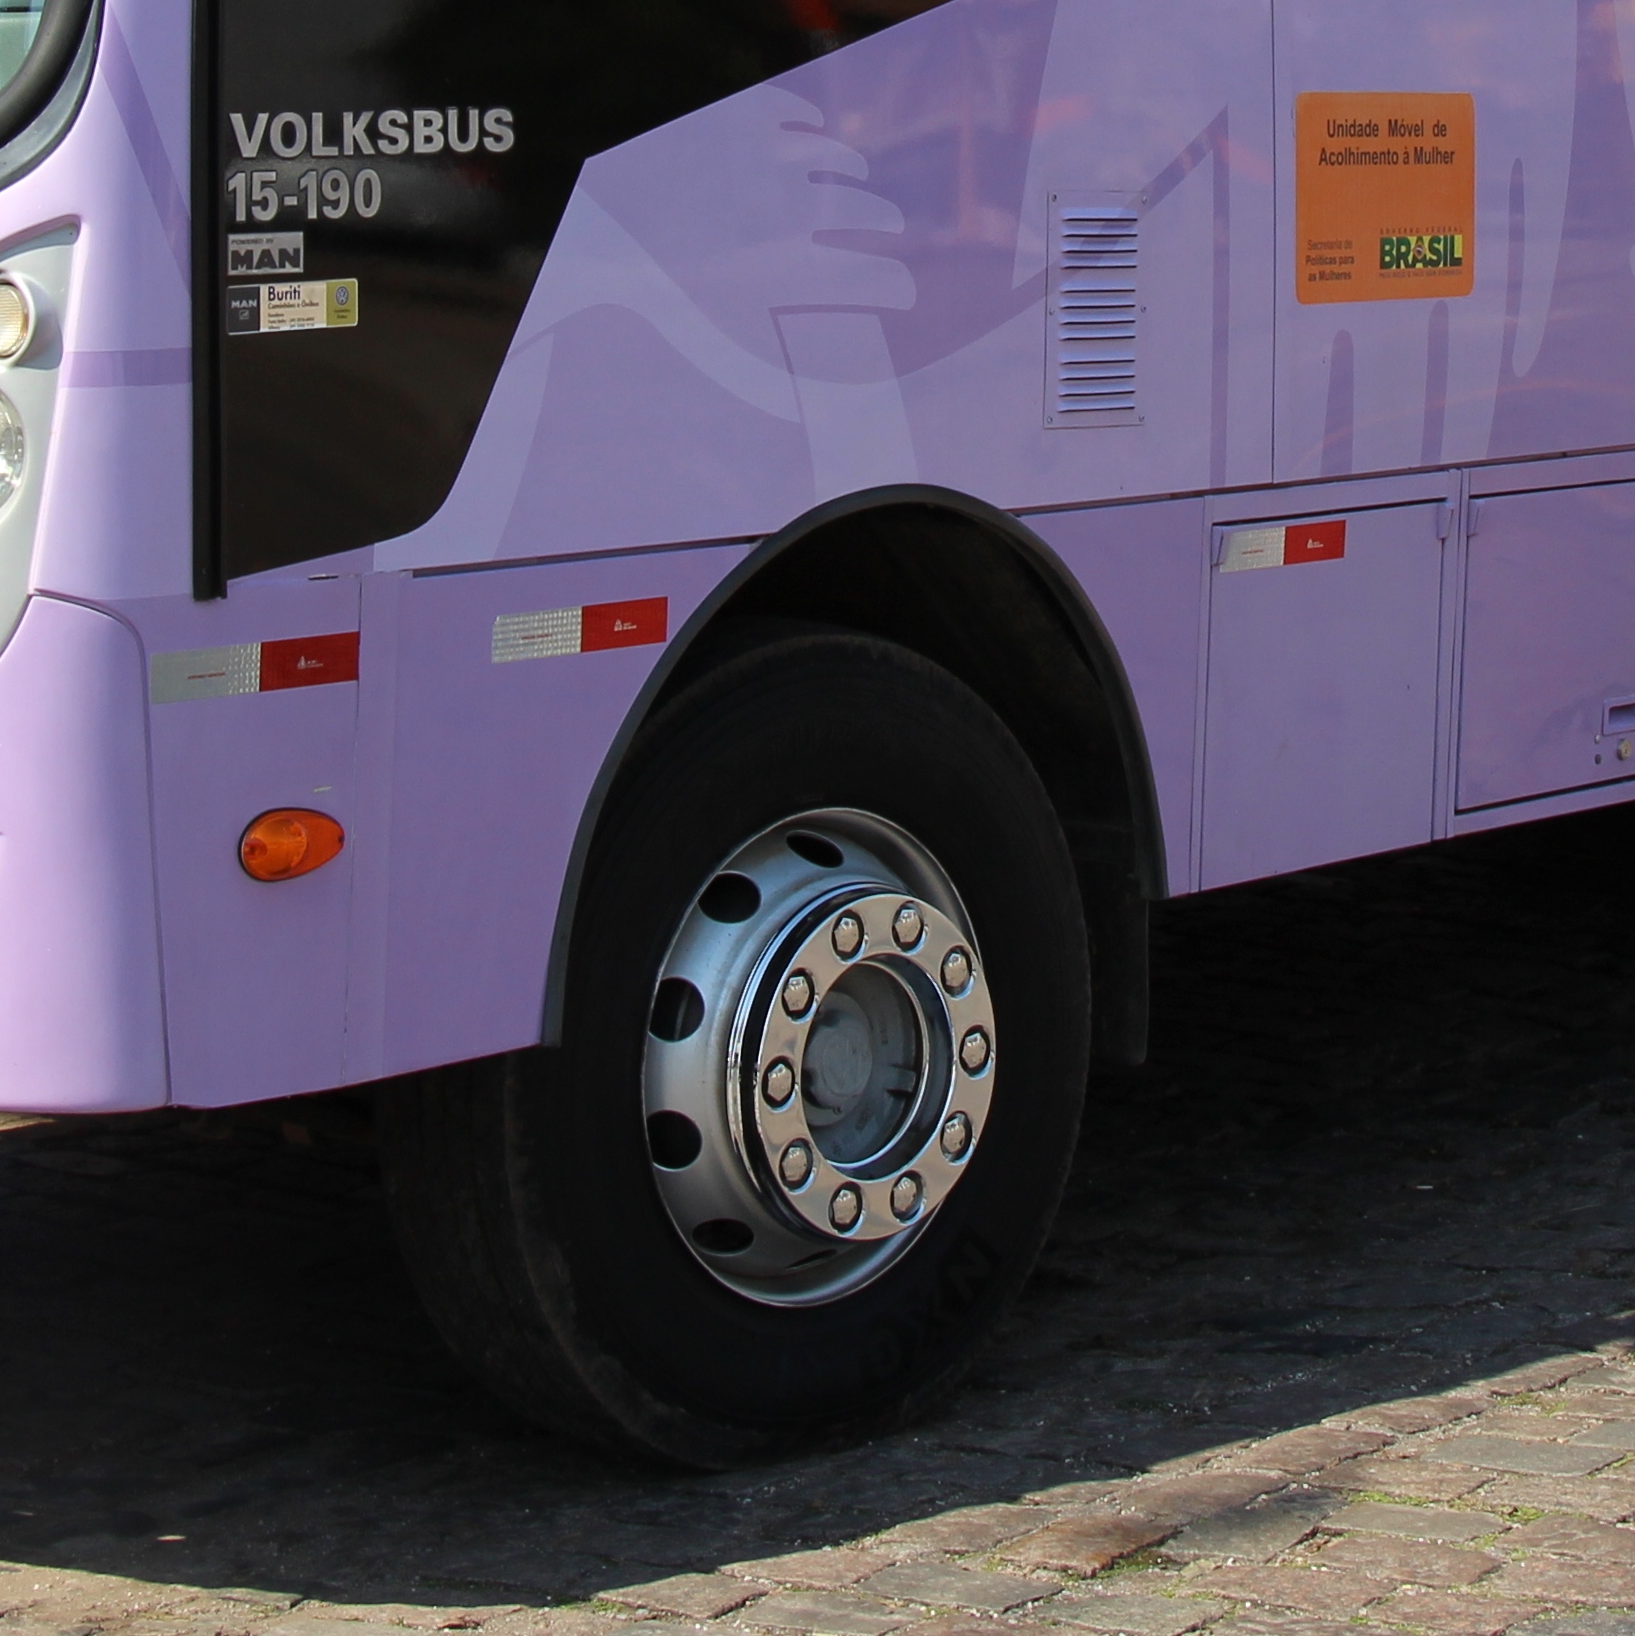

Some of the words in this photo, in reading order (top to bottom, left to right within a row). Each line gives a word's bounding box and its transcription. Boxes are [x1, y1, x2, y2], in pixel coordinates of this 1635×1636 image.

[228, 107, 516, 159] VOLKSBUS
[1326, 118, 1380, 139] Unidade
[1387, 118, 1424, 138] Móvel
[1432, 119, 1448, 138] de
[1318, 146, 1399, 167] Acolhimento
[1402, 146, 1410, 166] à
[1414, 146, 1455, 165] Mulher
[225, 168, 383, 223] 15-190
[230, 247, 301, 271] MAN
[1379, 234, 1463, 270] BRASIL
[230, 299, 257, 309] MAN
[267, 284, 301, 302] Buriti
